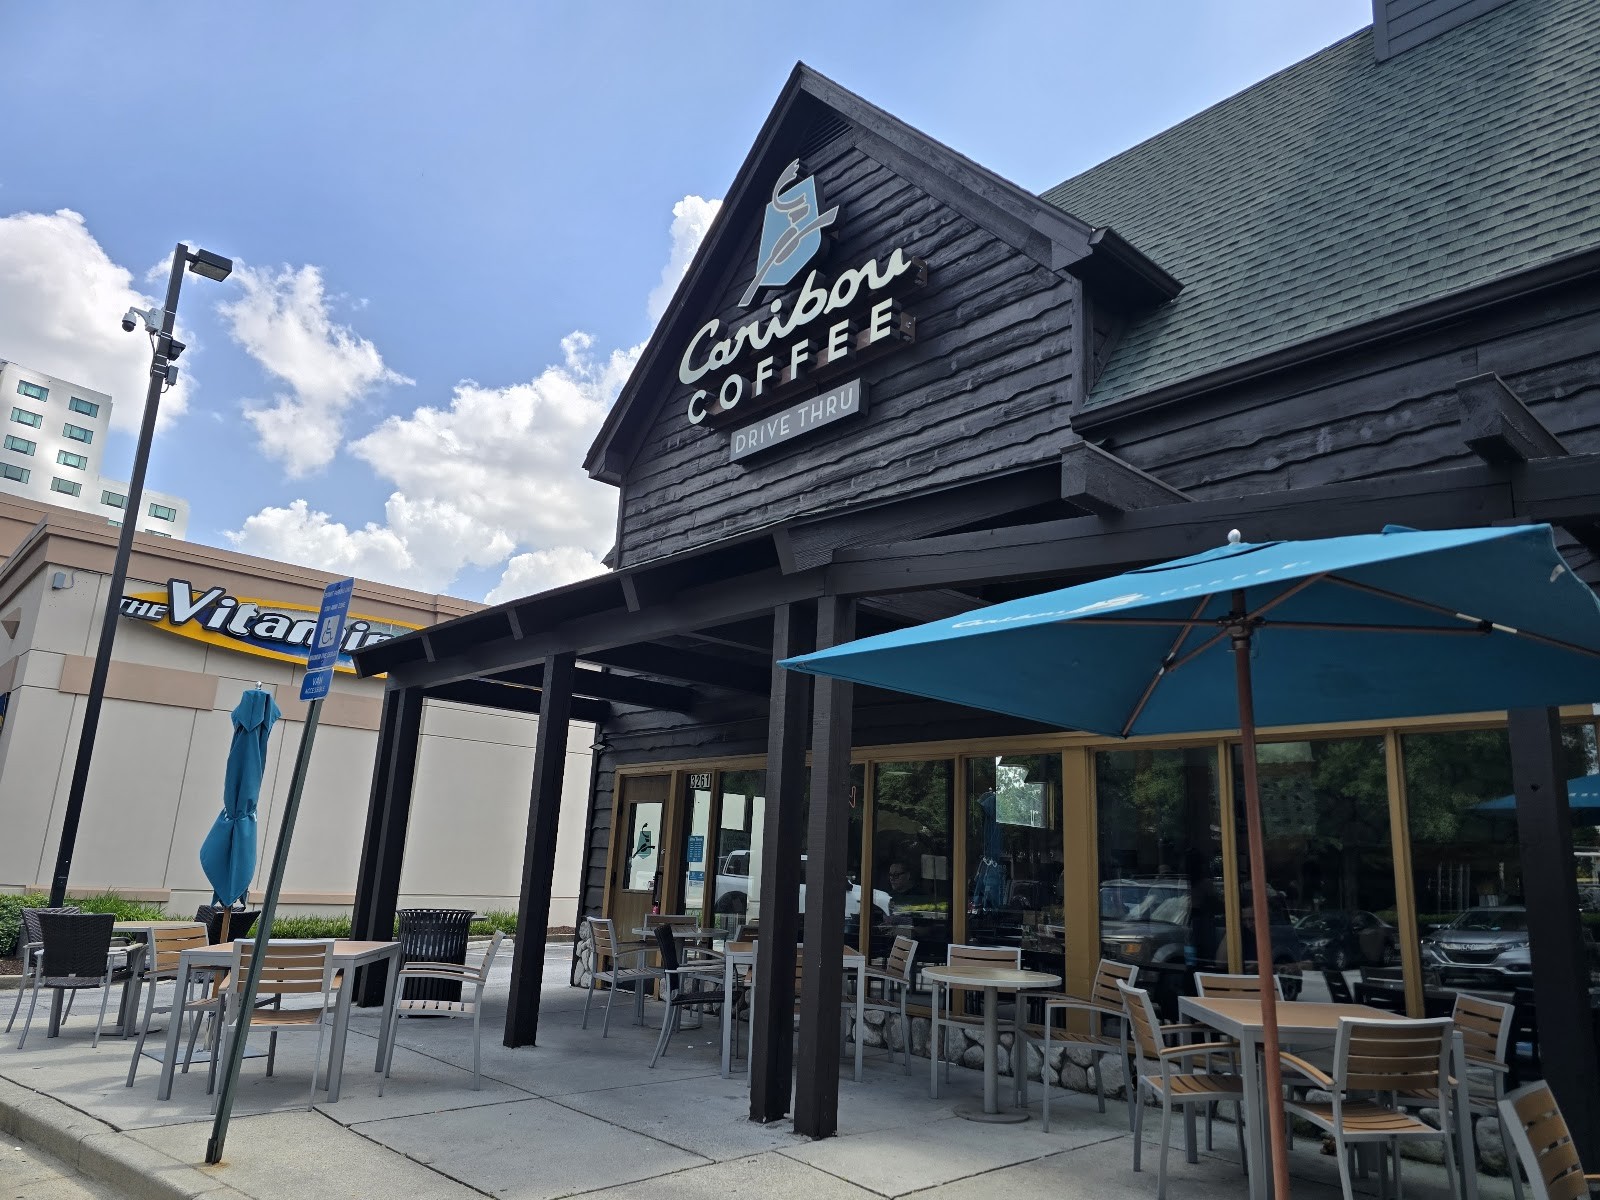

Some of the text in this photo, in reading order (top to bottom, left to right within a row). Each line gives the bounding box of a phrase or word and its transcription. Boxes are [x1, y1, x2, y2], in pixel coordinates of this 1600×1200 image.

[678, 247, 912, 385] Caribou
[687, 297, 893, 425] COFFEE
[735, 387, 853, 454] DRIVE THRU
[312, 676, 323, 686] VAN
[691, 774, 709, 788] 3261
